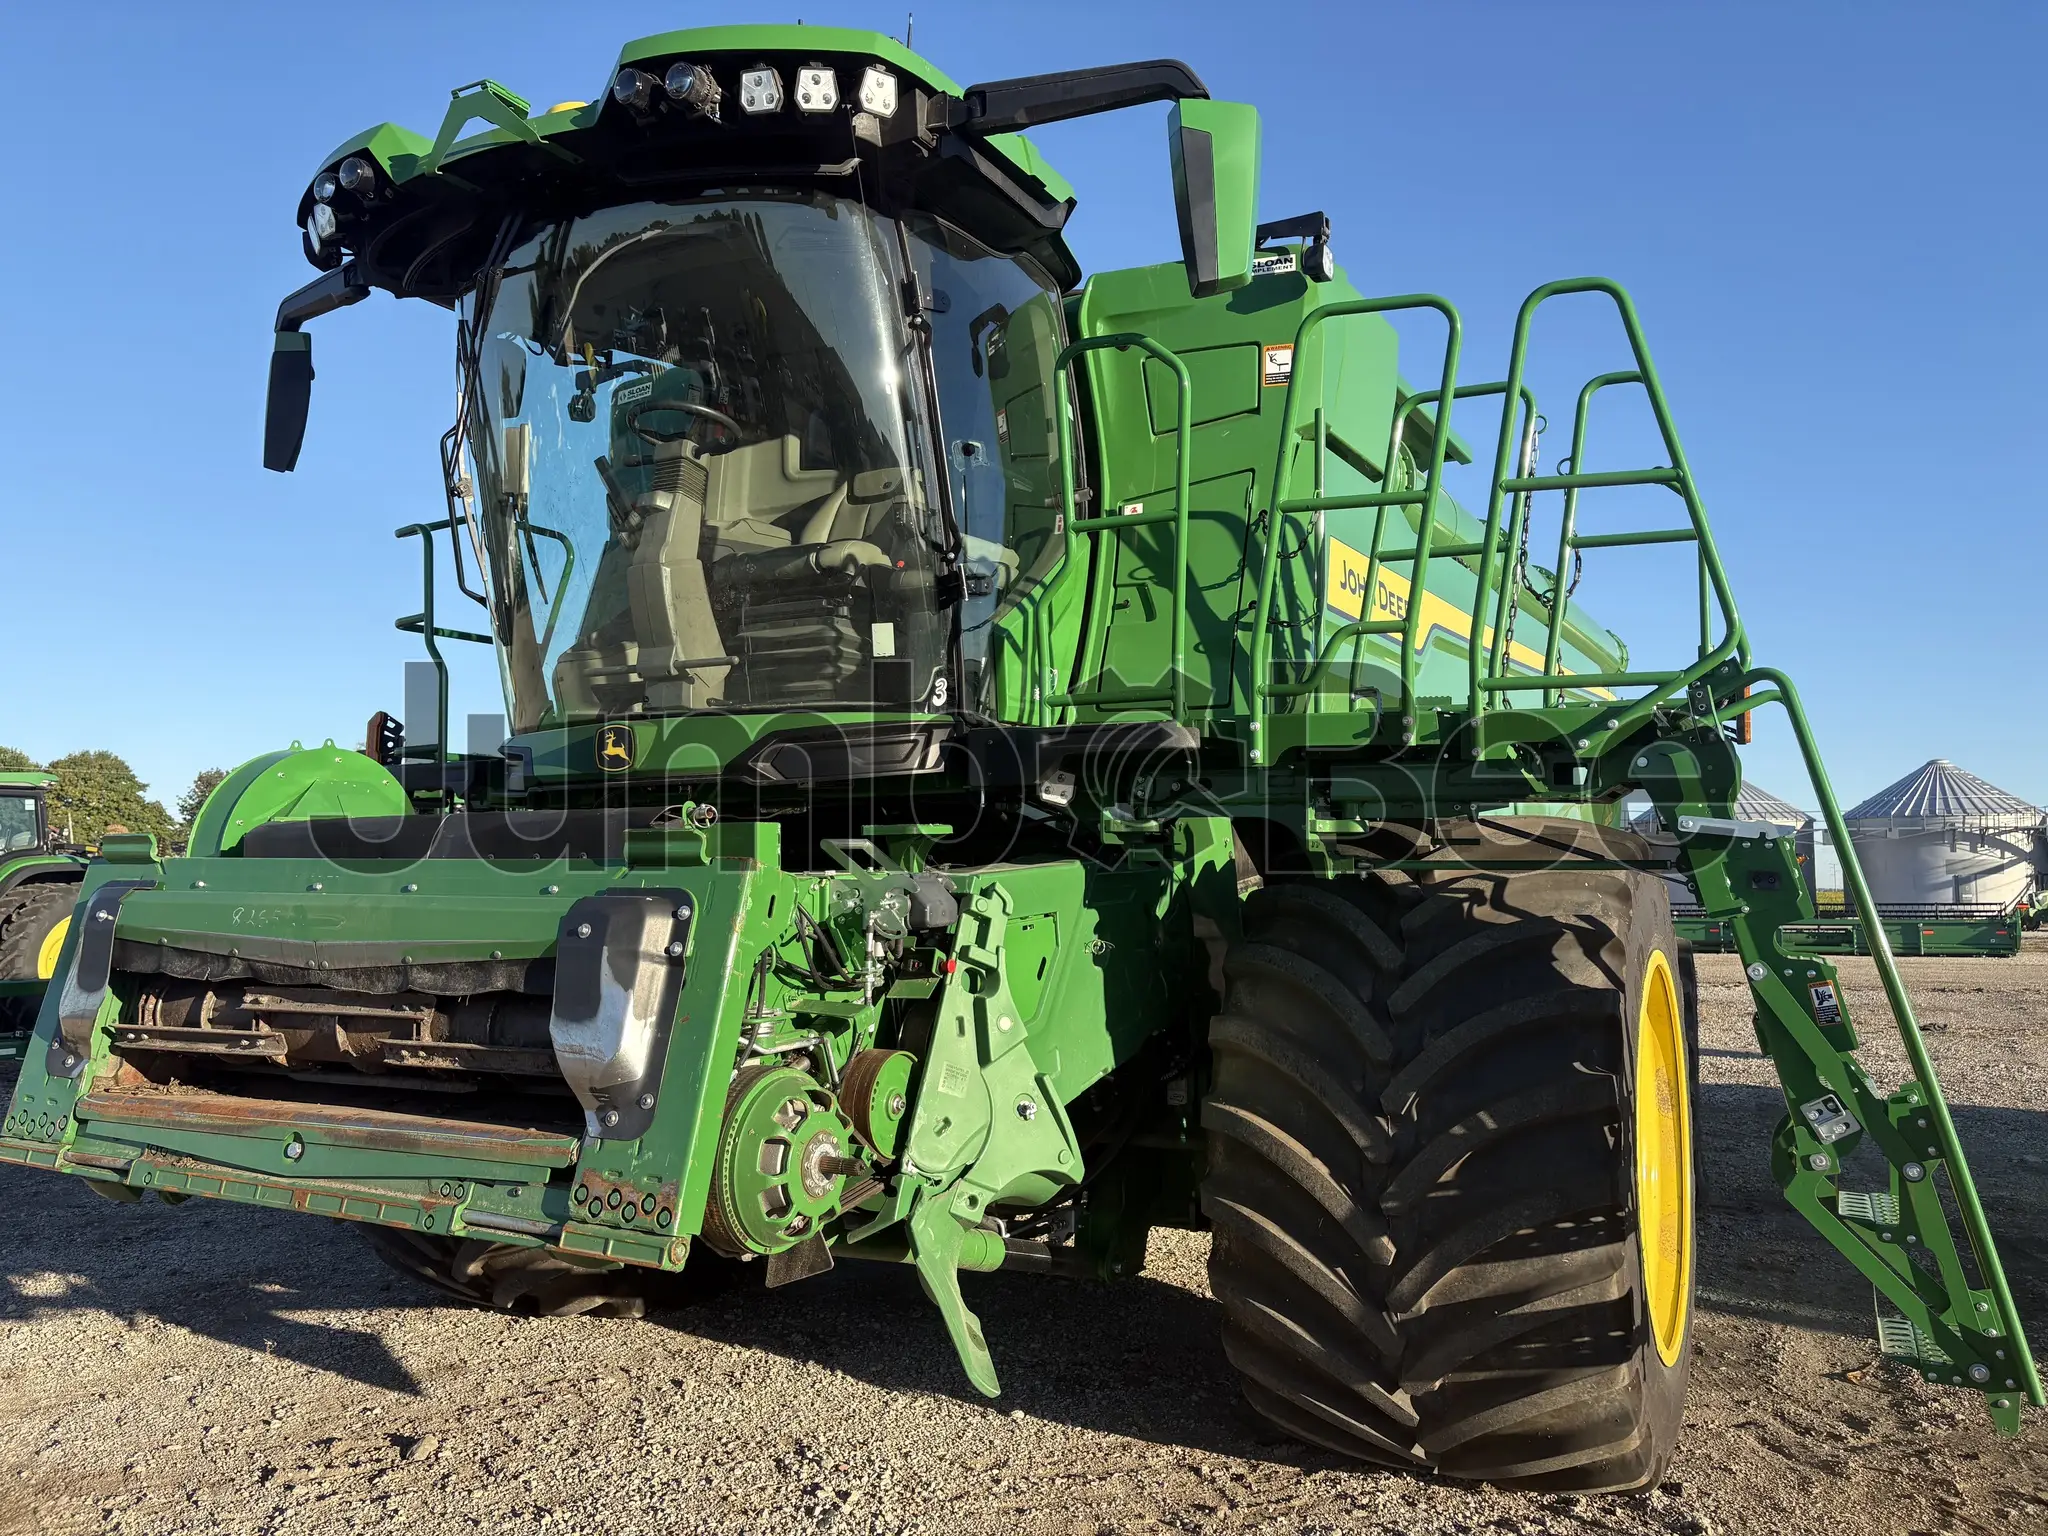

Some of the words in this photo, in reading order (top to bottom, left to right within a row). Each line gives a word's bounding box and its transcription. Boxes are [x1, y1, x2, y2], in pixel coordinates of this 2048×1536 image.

[1251, 264, 1294, 274] MPLEMENT
[627, 384, 651, 397] SLOAN
[1339, 559, 1376, 607] JOH
[1378, 580, 1409, 620] DEE
[932, 677, 948, 707] 3
